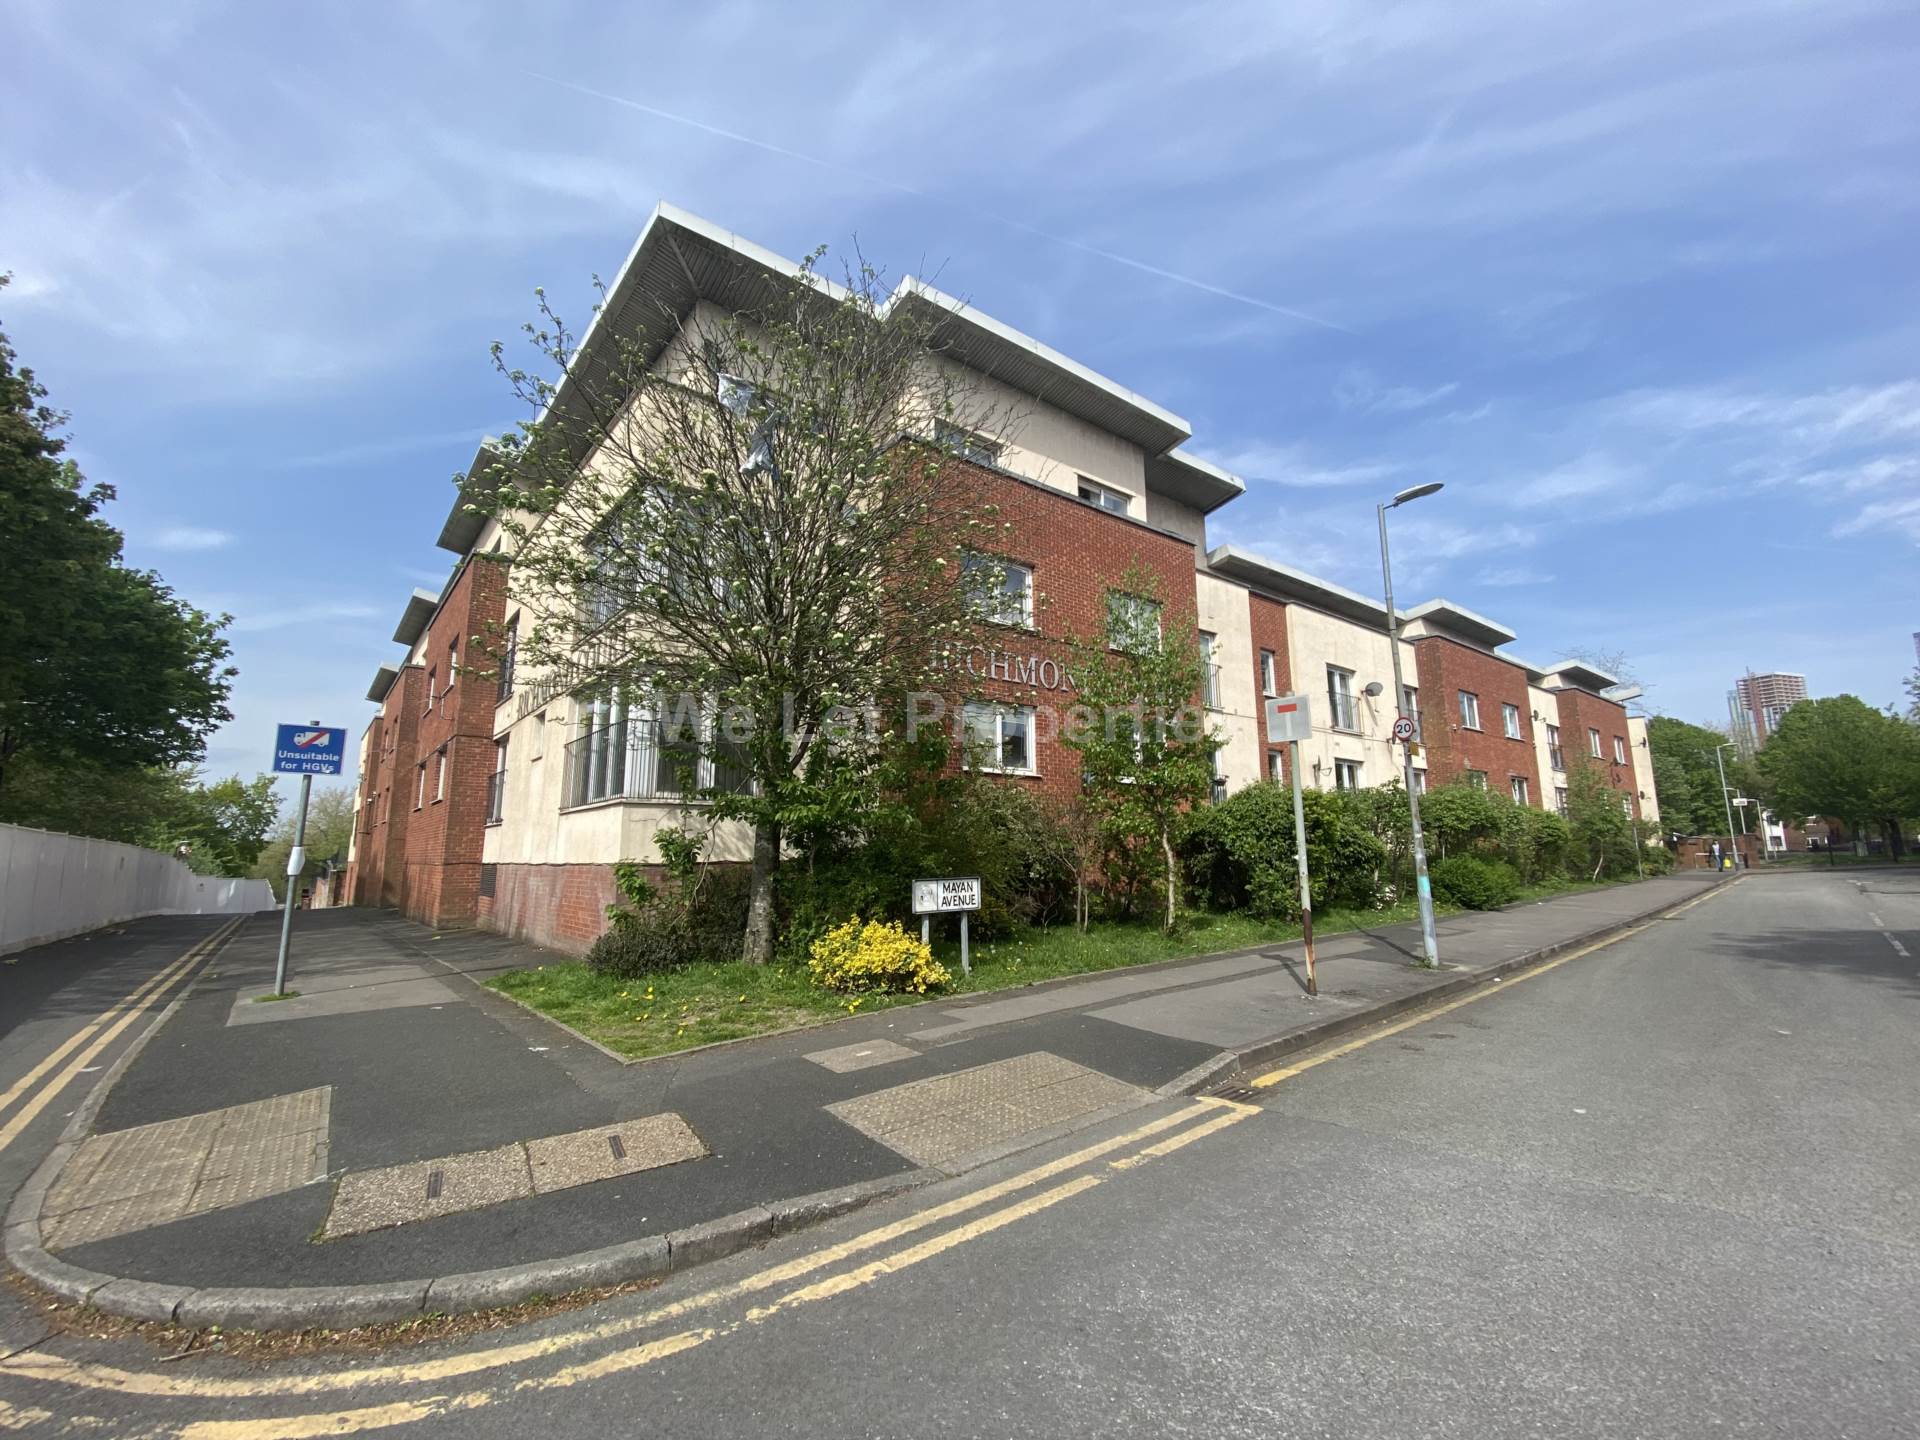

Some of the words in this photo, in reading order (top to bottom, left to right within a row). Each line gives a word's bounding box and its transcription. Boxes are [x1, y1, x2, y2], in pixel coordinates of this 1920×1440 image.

[1396, 723, 1411, 734] 20
[278, 750, 340, 761] Unsuitable
[280, 761, 298, 769] for
[302, 762, 335, 772] HGVs
[943, 881, 973, 894] MAYAN
[941, 895, 976, 907] AVENUE
